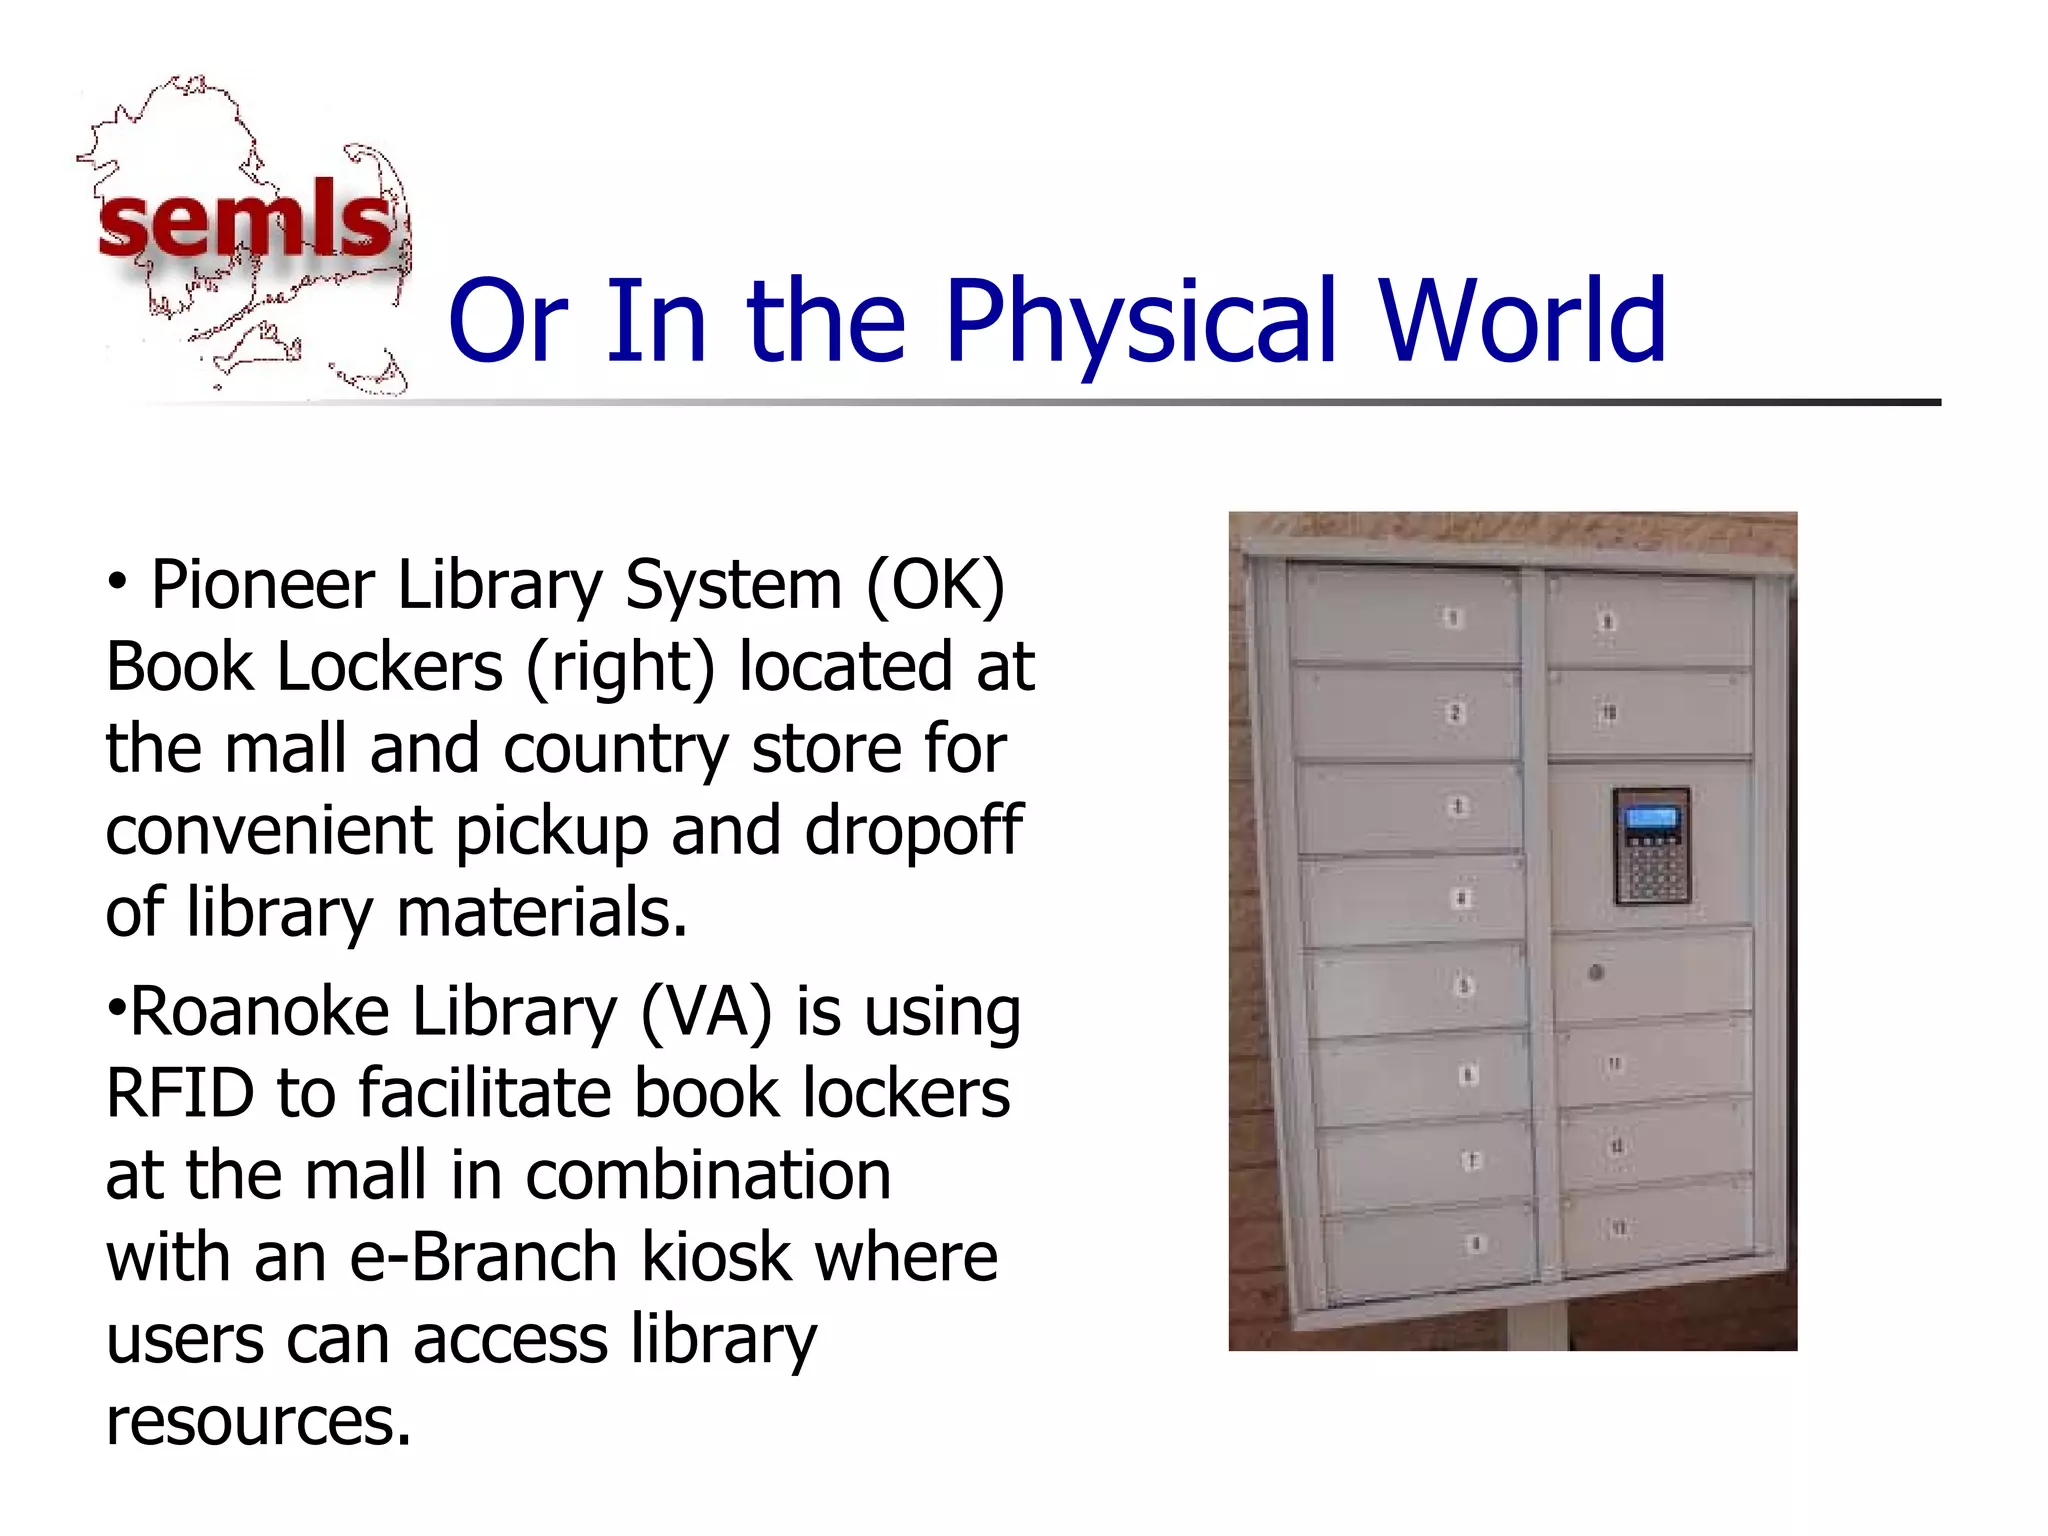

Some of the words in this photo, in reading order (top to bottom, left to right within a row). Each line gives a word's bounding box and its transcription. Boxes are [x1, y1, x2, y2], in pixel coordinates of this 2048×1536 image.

[99, 176, 393, 257] semls
[451, 276, 568, 363] Or
[609, 278, 703, 362] In
[747, 274, 904, 363] the
[951, 274, 1334, 385] Physical
[1378, 274, 1664, 363] World
[155, 556, 375, 610] Pioneer
[402, 556, 603, 622] Library
[628, 557, 840, 622] System
[869, 556, 1003, 622] (OK)
[110, 638, 255, 691] Book
[281, 638, 502, 691] Lockers
[528, 638, 713, 704] (right)
[743, 638, 950, 691] located
[978, 642, 1035, 691] at
[106, 720, 201, 773] the
[228, 720, 344, 773] mall
[372, 720, 477, 773] and
[505, 724, 729, 786] country
[754, 724, 901, 773] store
[925, 719, 1007, 773] for
[107, 804, 433, 855] convenient
[459, 802, 648, 867] pickup
[673, 802, 779, 855] and
[807, 801, 1026, 867] dropoff
[107, 883, 167, 937] of
[190, 884, 374, 949] library
[400, 884, 688, 937] materials.
[133, 983, 388, 1036] Roanoke
[416, 983, 618, 1048] Library
[643, 983, 770, 1048] (VA)
[800, 984, 840, 1035] is
[867, 984, 1019, 1049] using
[110, 1067, 253, 1117] RFID
[277, 1068, 335, 1117] to
[359, 1064, 610, 1118] facilitate
[638, 1064, 780, 1118] book
[806, 1064, 1010, 1118] lockers
[107, 1150, 164, 1199] at
[186, 1146, 281, 1199] the
[308, 1146, 424, 1199] mall
[454, 1148, 500, 1198] in
[527, 1146, 889, 1199] combination
[106, 1228, 228, 1281] with
[256, 1242, 324, 1281] an
[352, 1228, 615, 1281] e-Branch
[645, 1228, 793, 1281] kiosk
[815, 1228, 997, 1281] where
[109, 1324, 263, 1363] users
[288, 1324, 387, 1363] can
[415, 1324, 607, 1363] access
[634, 1310, 818, 1376] library
[110, 1406, 409, 1445] resources.
